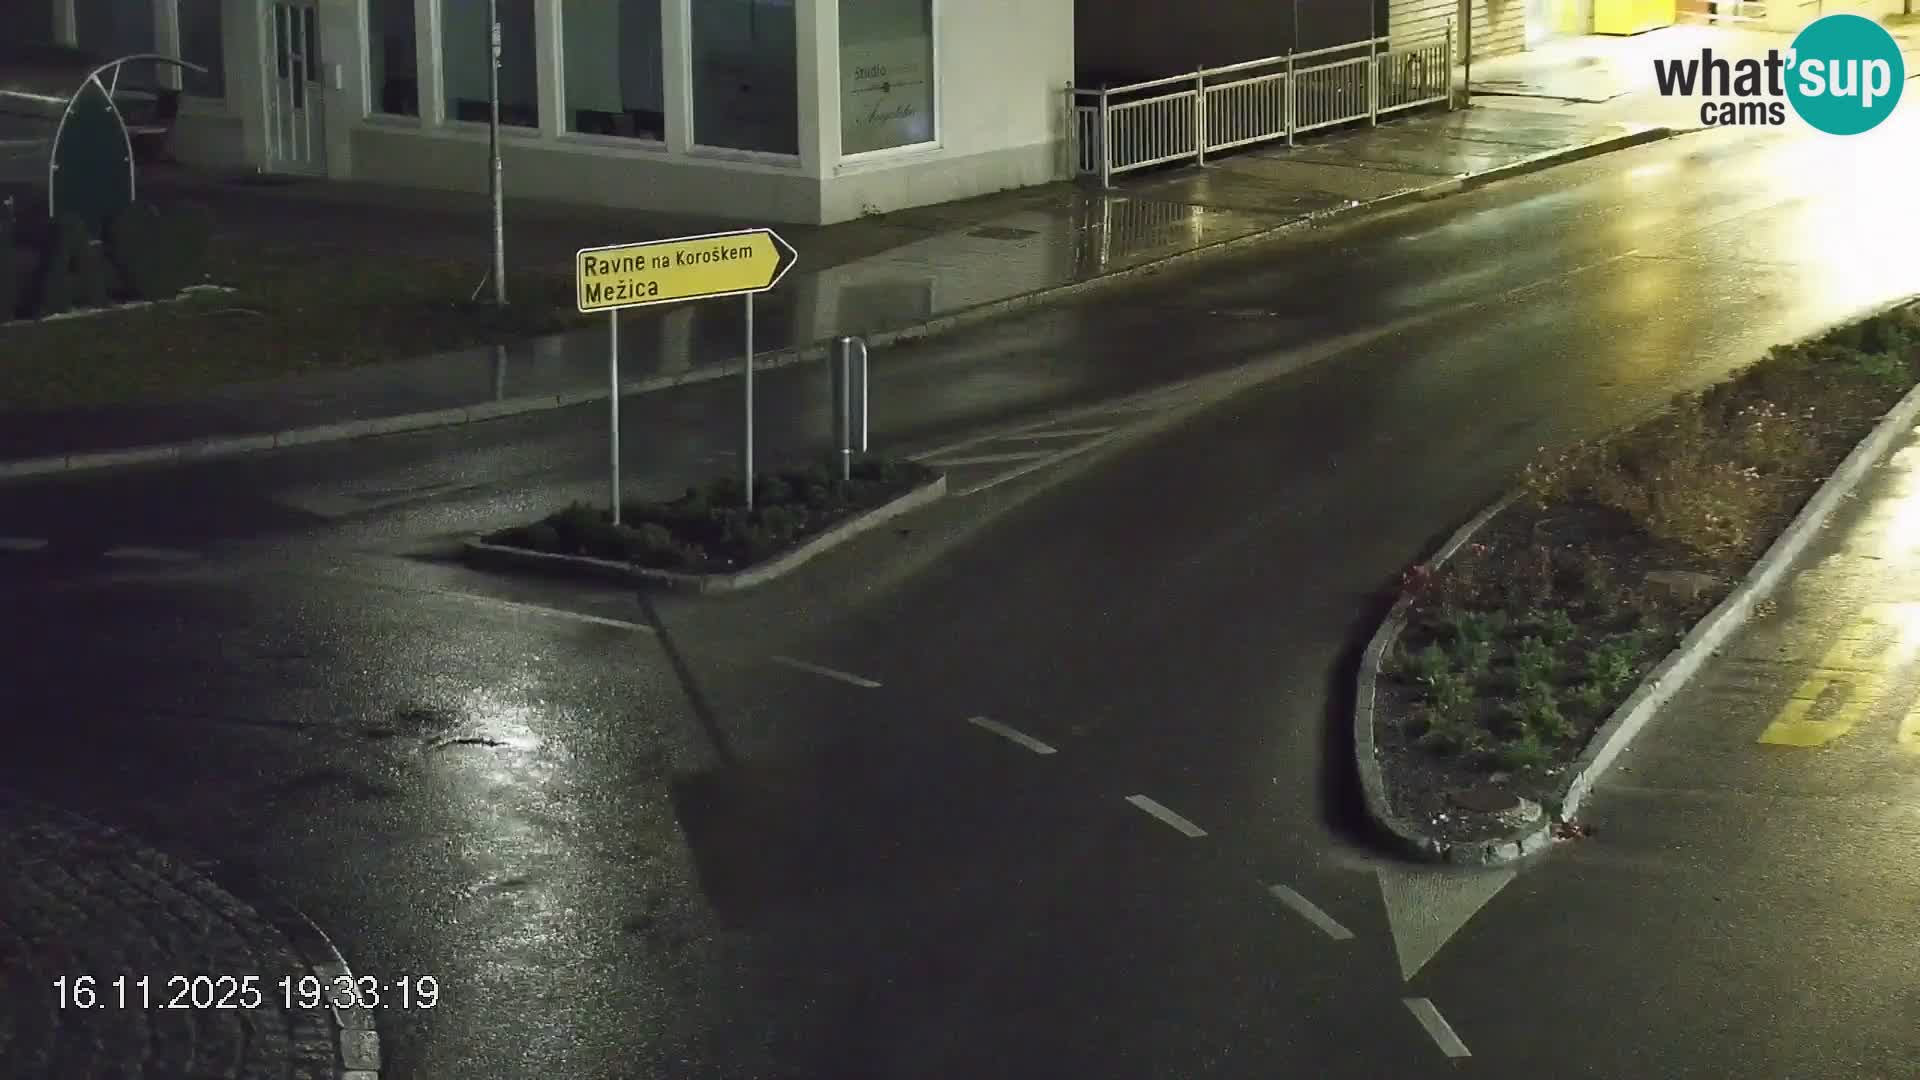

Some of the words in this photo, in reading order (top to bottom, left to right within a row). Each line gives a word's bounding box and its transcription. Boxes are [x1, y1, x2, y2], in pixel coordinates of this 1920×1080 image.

[584, 255, 645, 277] Ravne
[652, 255, 670, 269] na
[676, 245, 753, 266] Koroškem
[585, 279, 658, 304] Mežica
